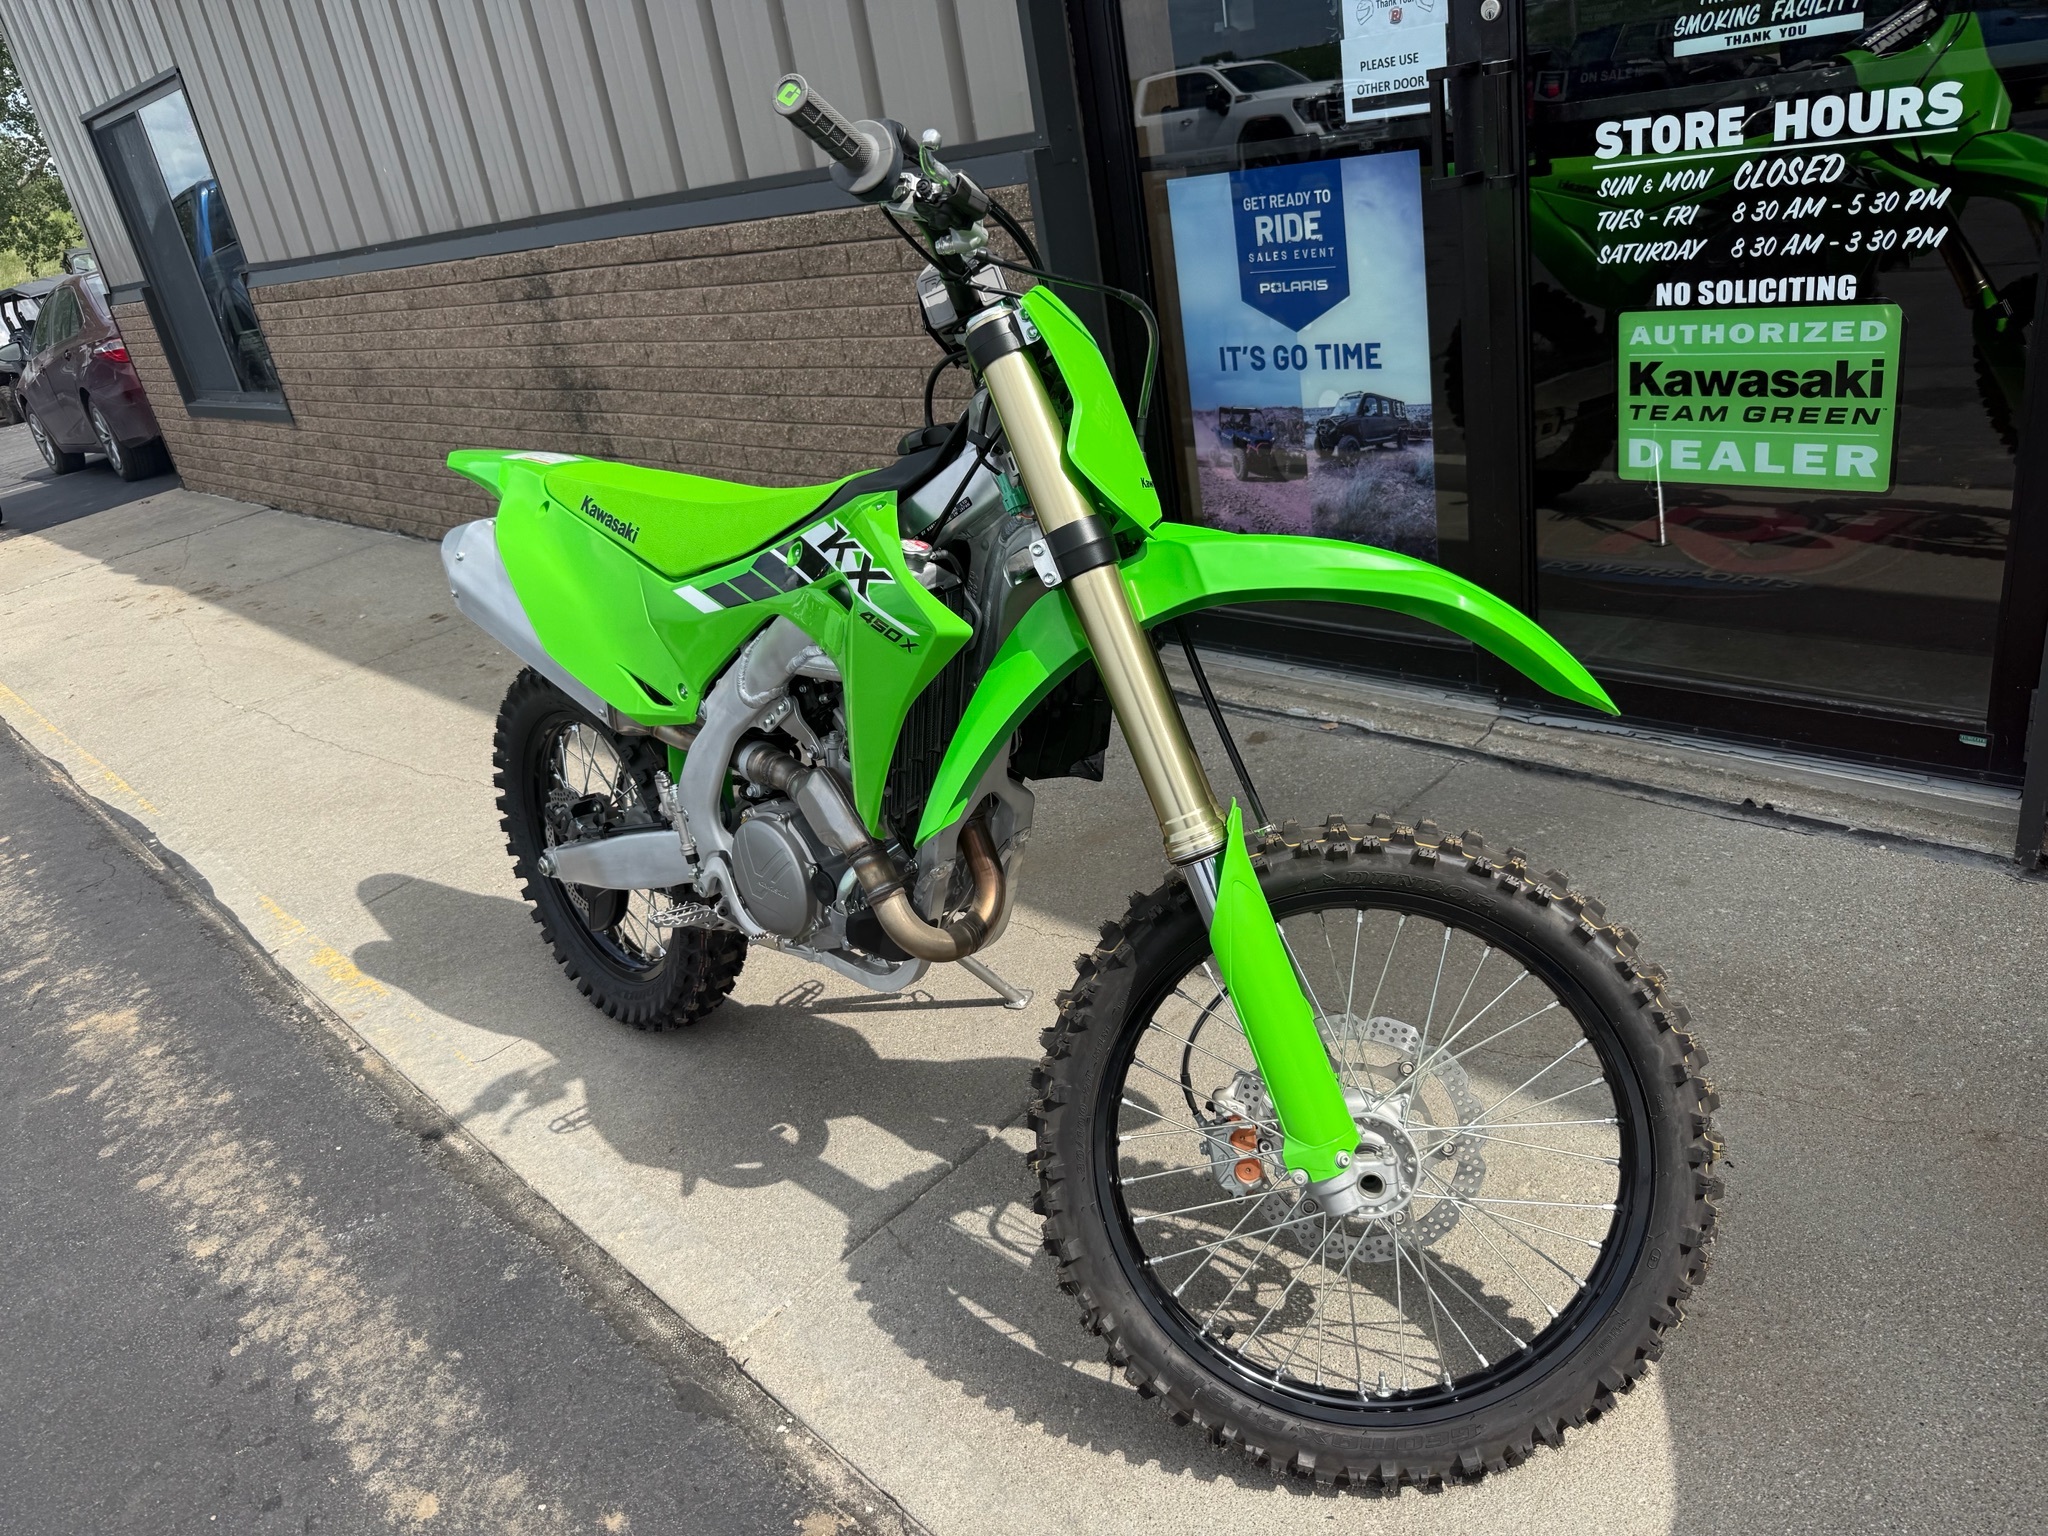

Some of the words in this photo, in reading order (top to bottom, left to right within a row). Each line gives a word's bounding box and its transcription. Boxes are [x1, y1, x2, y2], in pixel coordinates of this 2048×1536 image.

[1674, 4, 1761, 37] SMOKING
[1724, 31, 1771, 47] THANK
[1780, 25, 1807, 38] YOU
[1360, 56, 1396, 72] PLEASE
[1399, 52, 1419, 66] USE
[1357, 80, 1391, 96] OTHER
[1394, 76, 1425, 91] DOOR
[1595, 106, 1744, 160] STORE
[1773, 81, 1964, 142] HOURS
[1597, 174, 1643, 198] SUN
[1643, 178, 1653, 194] &
[1658, 167, 1715, 192] MON
[1734, 153, 1846, 191] CLOSED
[1243, 196, 1266, 211] GET
[1269, 191, 1311, 209] READY
[1313, 189, 1331, 204] TO
[1597, 208, 1644, 232] TUES
[1662, 204, 1700, 227] FRI
[1782, 196, 1828, 220] AM
[1904, 187, 1952, 212] PM
[1255, 210, 1323, 247] RIDE
[1248, 250, 1287, 263] SALES
[1294, 247, 1335, 260] EVENT
[1597, 238, 1708, 264] SATURDAY
[1780, 233, 1825, 256] AM
[1902, 226, 1949, 250] PM
[1259, 279, 1329, 294] POLARIS
[1656, 282, 1690, 306] NO
[1698, 275, 1857, 305] SOLICITING
[1629, 320, 1887, 346] AUTHORIZED
[1219, 345, 1266, 372] IT'S
[1273, 345, 1308, 371] GO
[1315, 343, 1382, 370] TIME
[1629, 359, 1886, 399] Kawasaki
[1630, 405, 1729, 422] TEAM
[1628, 438, 1879, 478] DEALER
[580, 495, 640, 544] Kawasaki
[817, 523, 895, 602] KX
